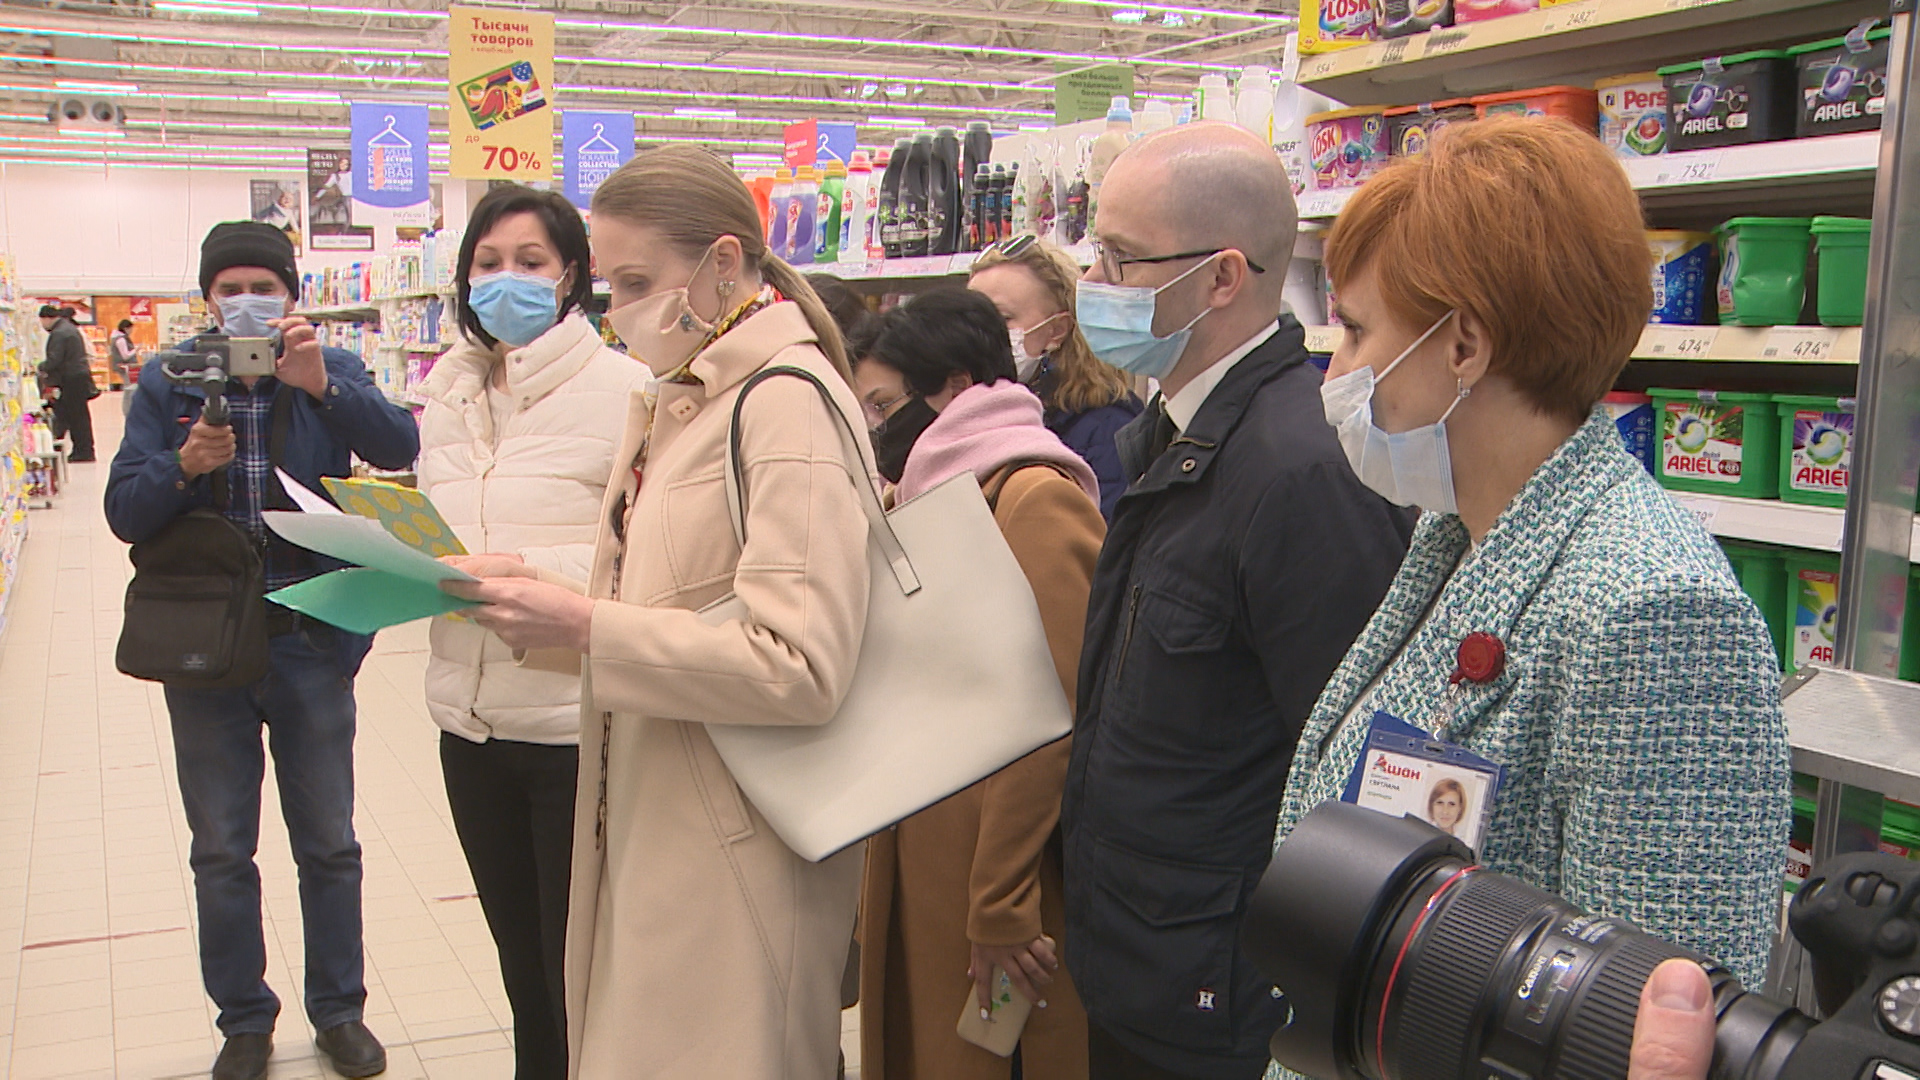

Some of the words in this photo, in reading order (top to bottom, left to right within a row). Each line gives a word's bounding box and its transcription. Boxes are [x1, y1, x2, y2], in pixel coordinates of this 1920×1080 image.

[1327, 0, 1370, 21] LOSK
[471, 17, 529, 33] Тысячи
[471, 33, 533, 48] товаров
[1624, 89, 1667, 110] Pers
[1813, 101, 1861, 122] ARIEL
[1682, 115, 1723, 135] ARIEL
[1311, 126, 1336, 160] LOSK
[482, 146, 541, 171] 70%
[368, 166, 412, 178] НВАЯ
[1677, 339, 1702, 352] 474
[1793, 341, 1821, 356] 474
[1667, 455, 1716, 474] ARIEL
[1810, 645, 1833, 662] AR
[1372, 753, 1421, 780] Ашан
[1518, 955, 1547, 999] Canon
